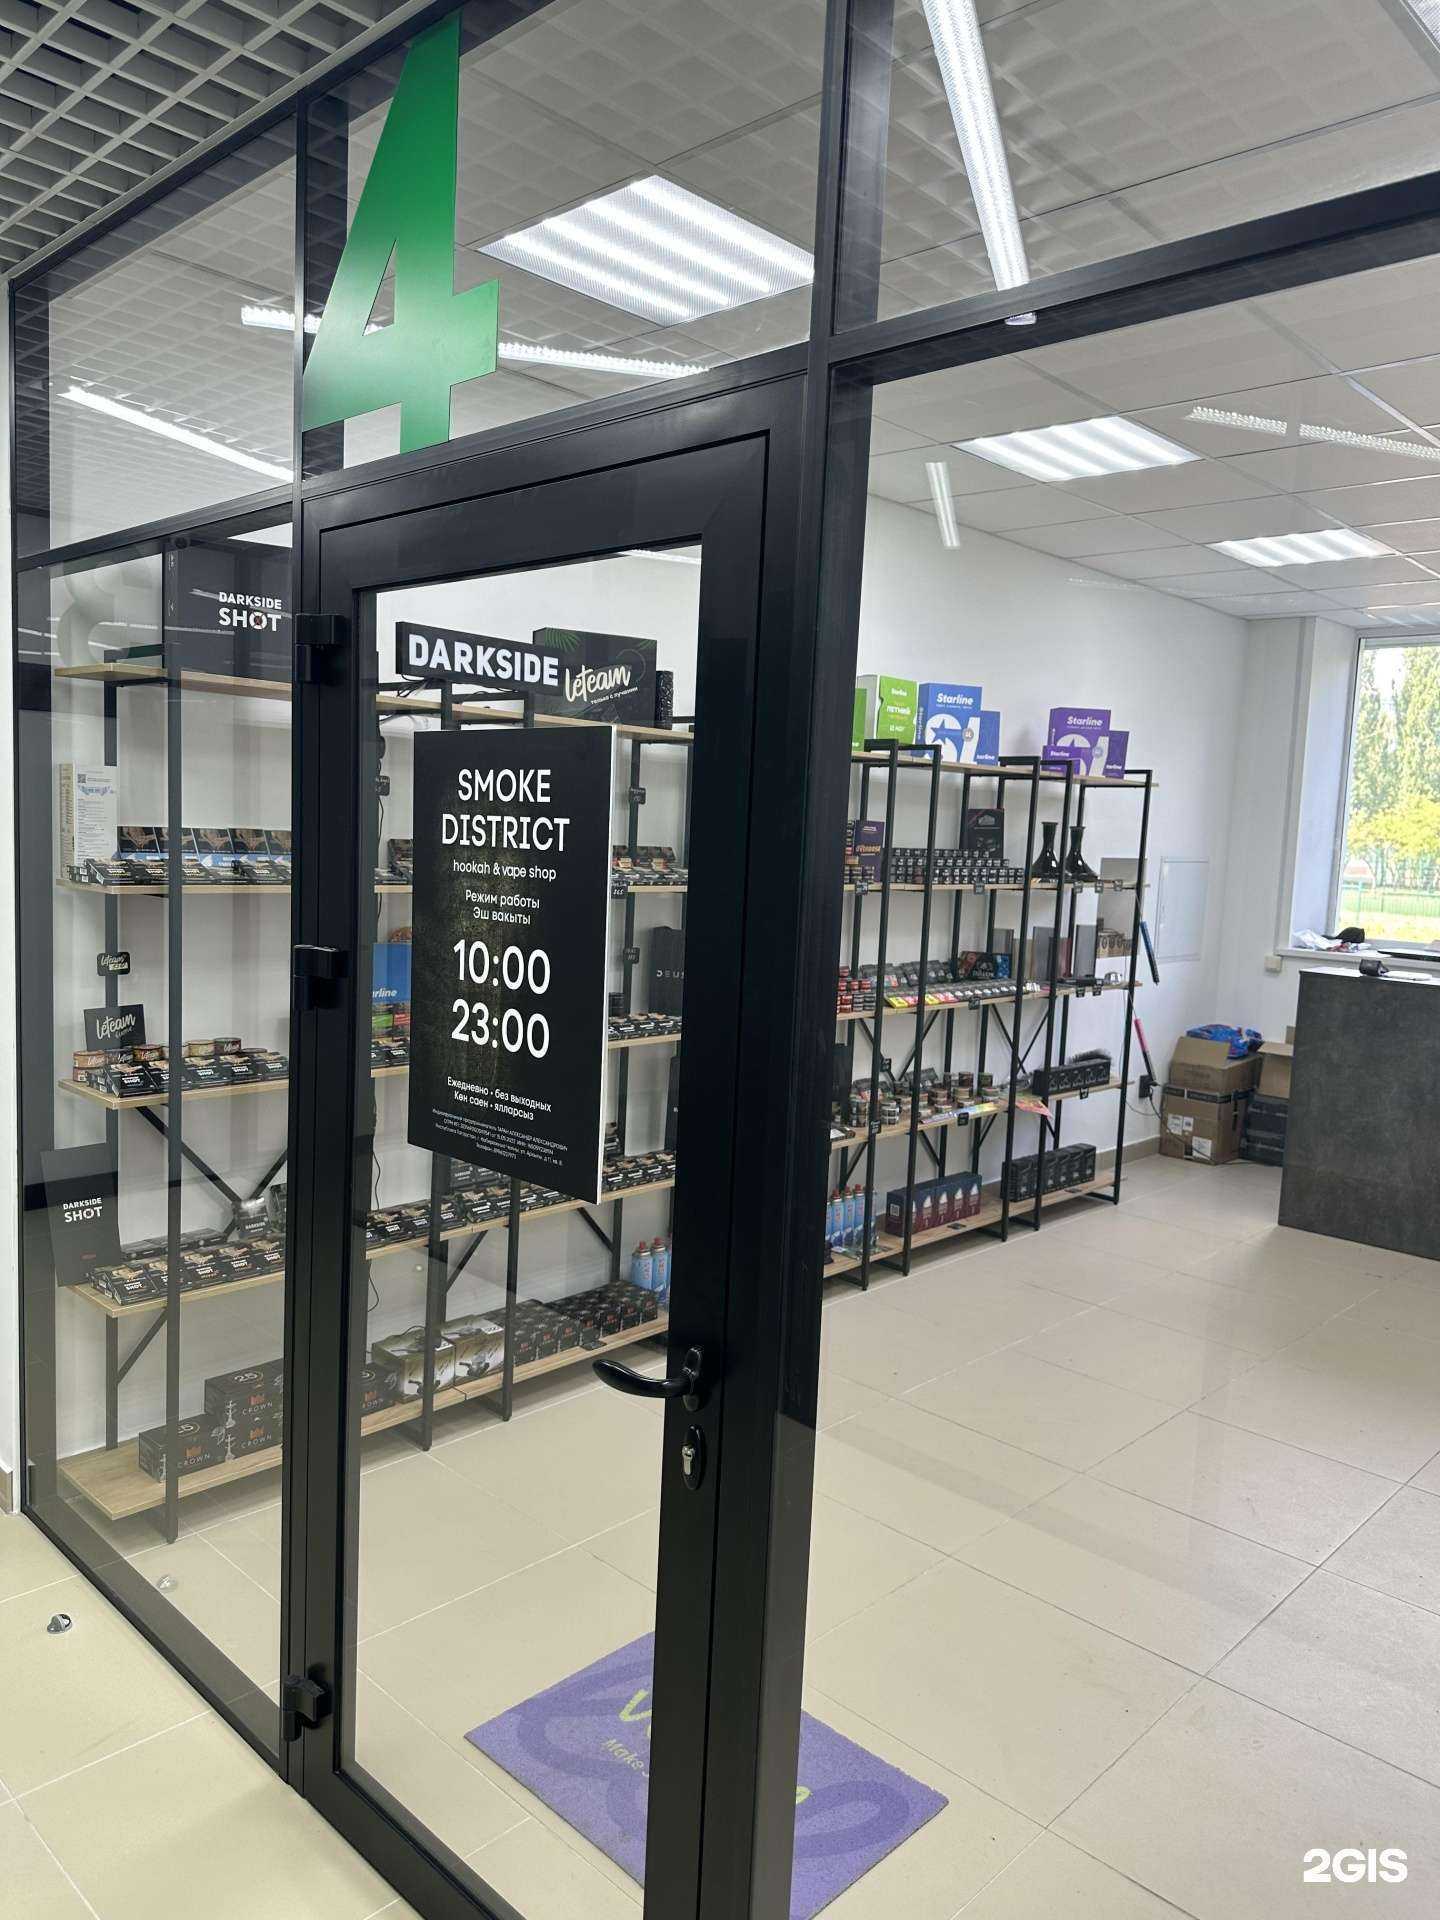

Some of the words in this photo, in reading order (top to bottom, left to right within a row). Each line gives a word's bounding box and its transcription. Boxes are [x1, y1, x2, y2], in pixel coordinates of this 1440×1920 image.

[302, 8, 499, 454] 4
[218, 591, 282, 610] DARKSIDE
[218, 607, 282, 632] SHOT
[408, 633, 559, 687] DARKSIDE
[936, 693, 974, 706] Starline
[1066, 716, 1103, 727] Starline
[457, 768, 552, 803] SMOKE
[441, 813, 571, 852] DISTRICT
[453, 859, 491, 875] hookah
[493, 862, 501, 876] &
[501, 865, 527, 880] vape
[529, 865, 557, 882] shop
[465, 889, 498, 905] Режим
[500, 894, 540, 909] работы
[473, 906, 490, 920] Эш
[492, 911, 531, 925] вакыты
[453, 938, 551, 995] 10:00
[451, 998, 550, 1059] 23:00
[447, 1076, 489, 1096] Ежедневно
[494, 1088, 509, 1101] без
[510, 1094, 552, 1113] выходных
[454, 1090, 468, 1103] Көн
[494, 1103, 534, 1121] ялларсыз
[62, 1197, 103, 1210] DARKSIDE
[64, 1206, 103, 1223] SHOT
[242, 1401, 273, 1415] CROWN
[241, 1434, 272, 1449] CROWN
